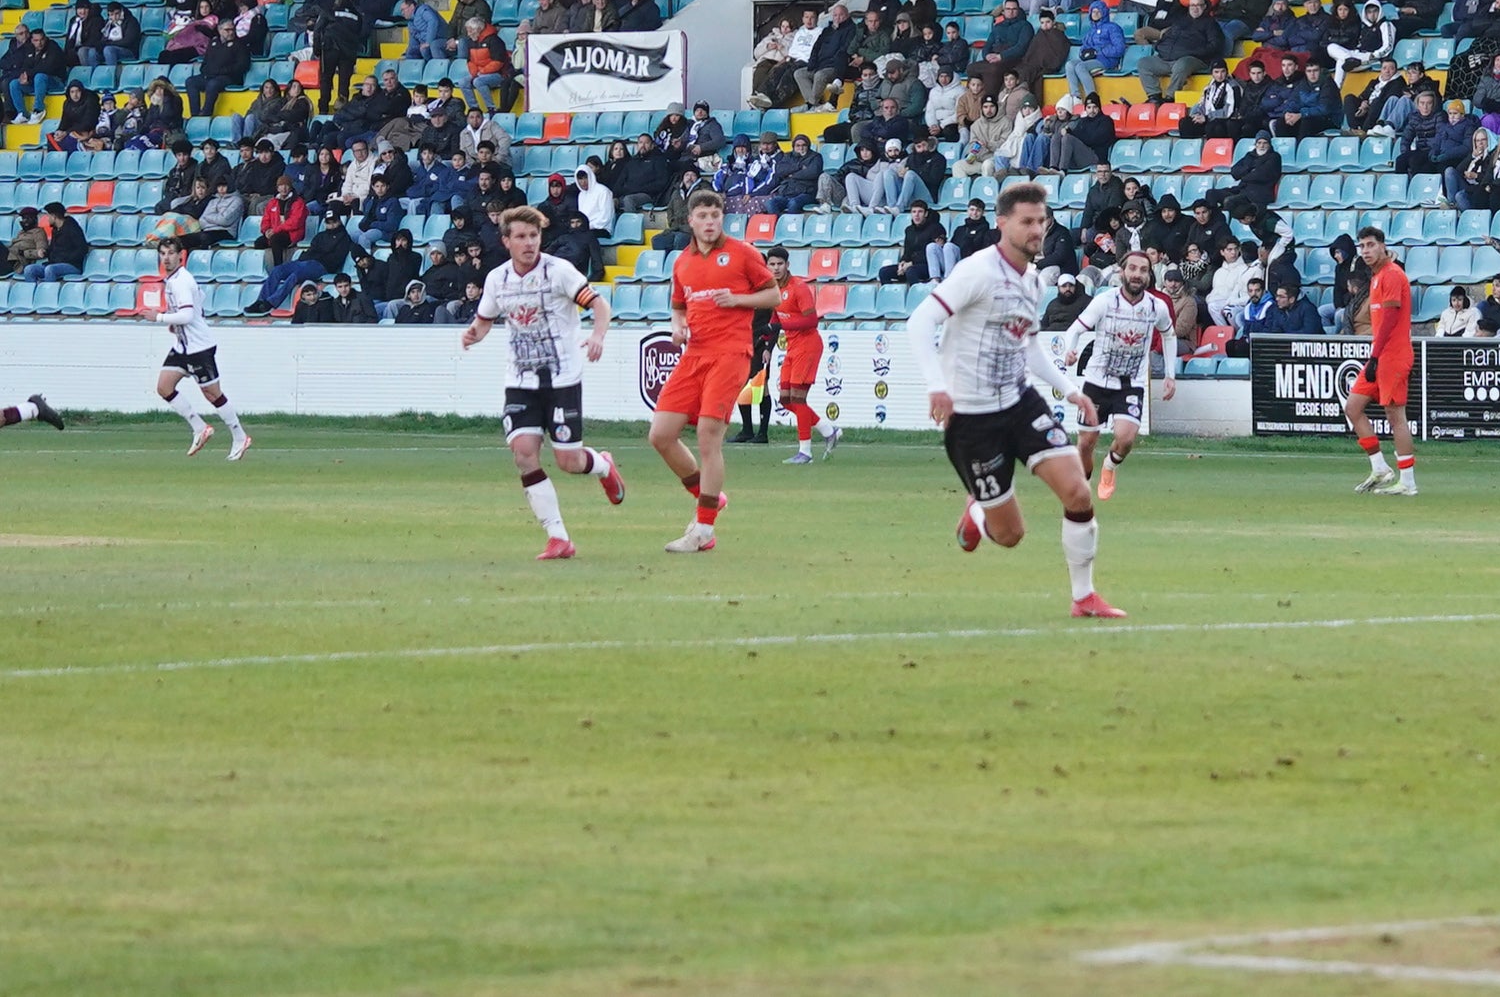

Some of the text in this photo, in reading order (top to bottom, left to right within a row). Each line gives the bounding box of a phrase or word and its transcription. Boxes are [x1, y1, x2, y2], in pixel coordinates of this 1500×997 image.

[562, 46, 650, 77] ALJOMAR
[1291, 342, 1328, 358] PINTURA
[1329, 343, 1341, 358] EN
[1296, 403, 1340, 417] DESDE 1999
[976, 475, 1000, 500] 23
